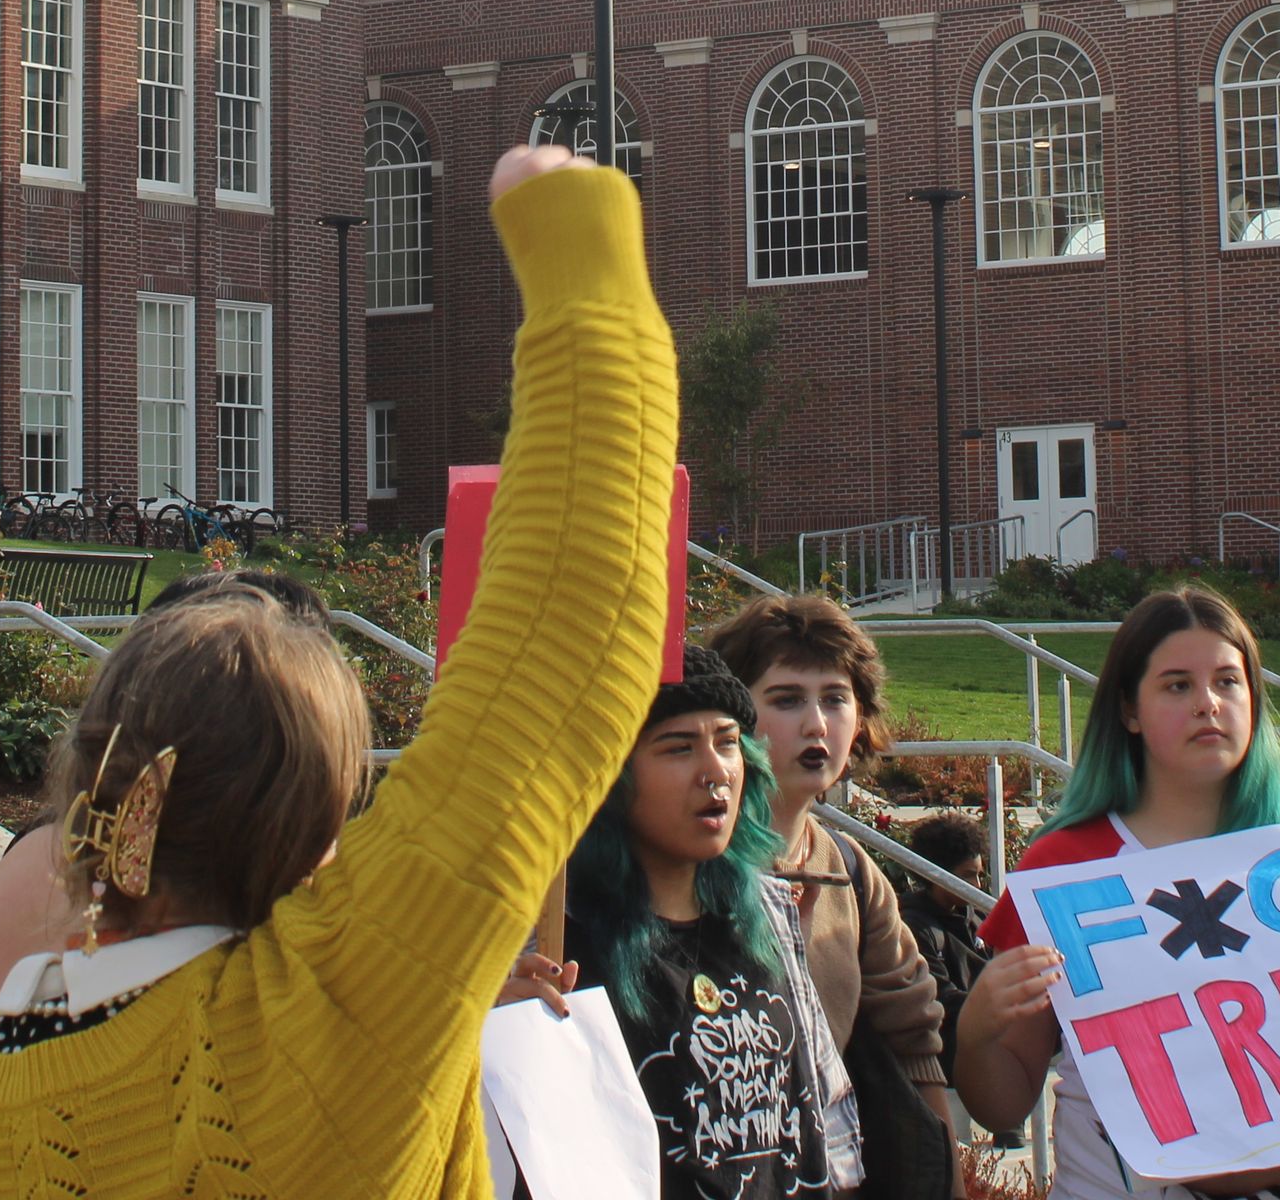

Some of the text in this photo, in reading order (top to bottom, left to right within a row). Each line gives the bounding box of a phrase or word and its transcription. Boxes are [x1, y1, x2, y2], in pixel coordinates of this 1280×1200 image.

[1001, 431, 1012, 444] 43
[692, 1008, 782, 1053] STARS
[718, 1063, 780, 1114] MEAN
